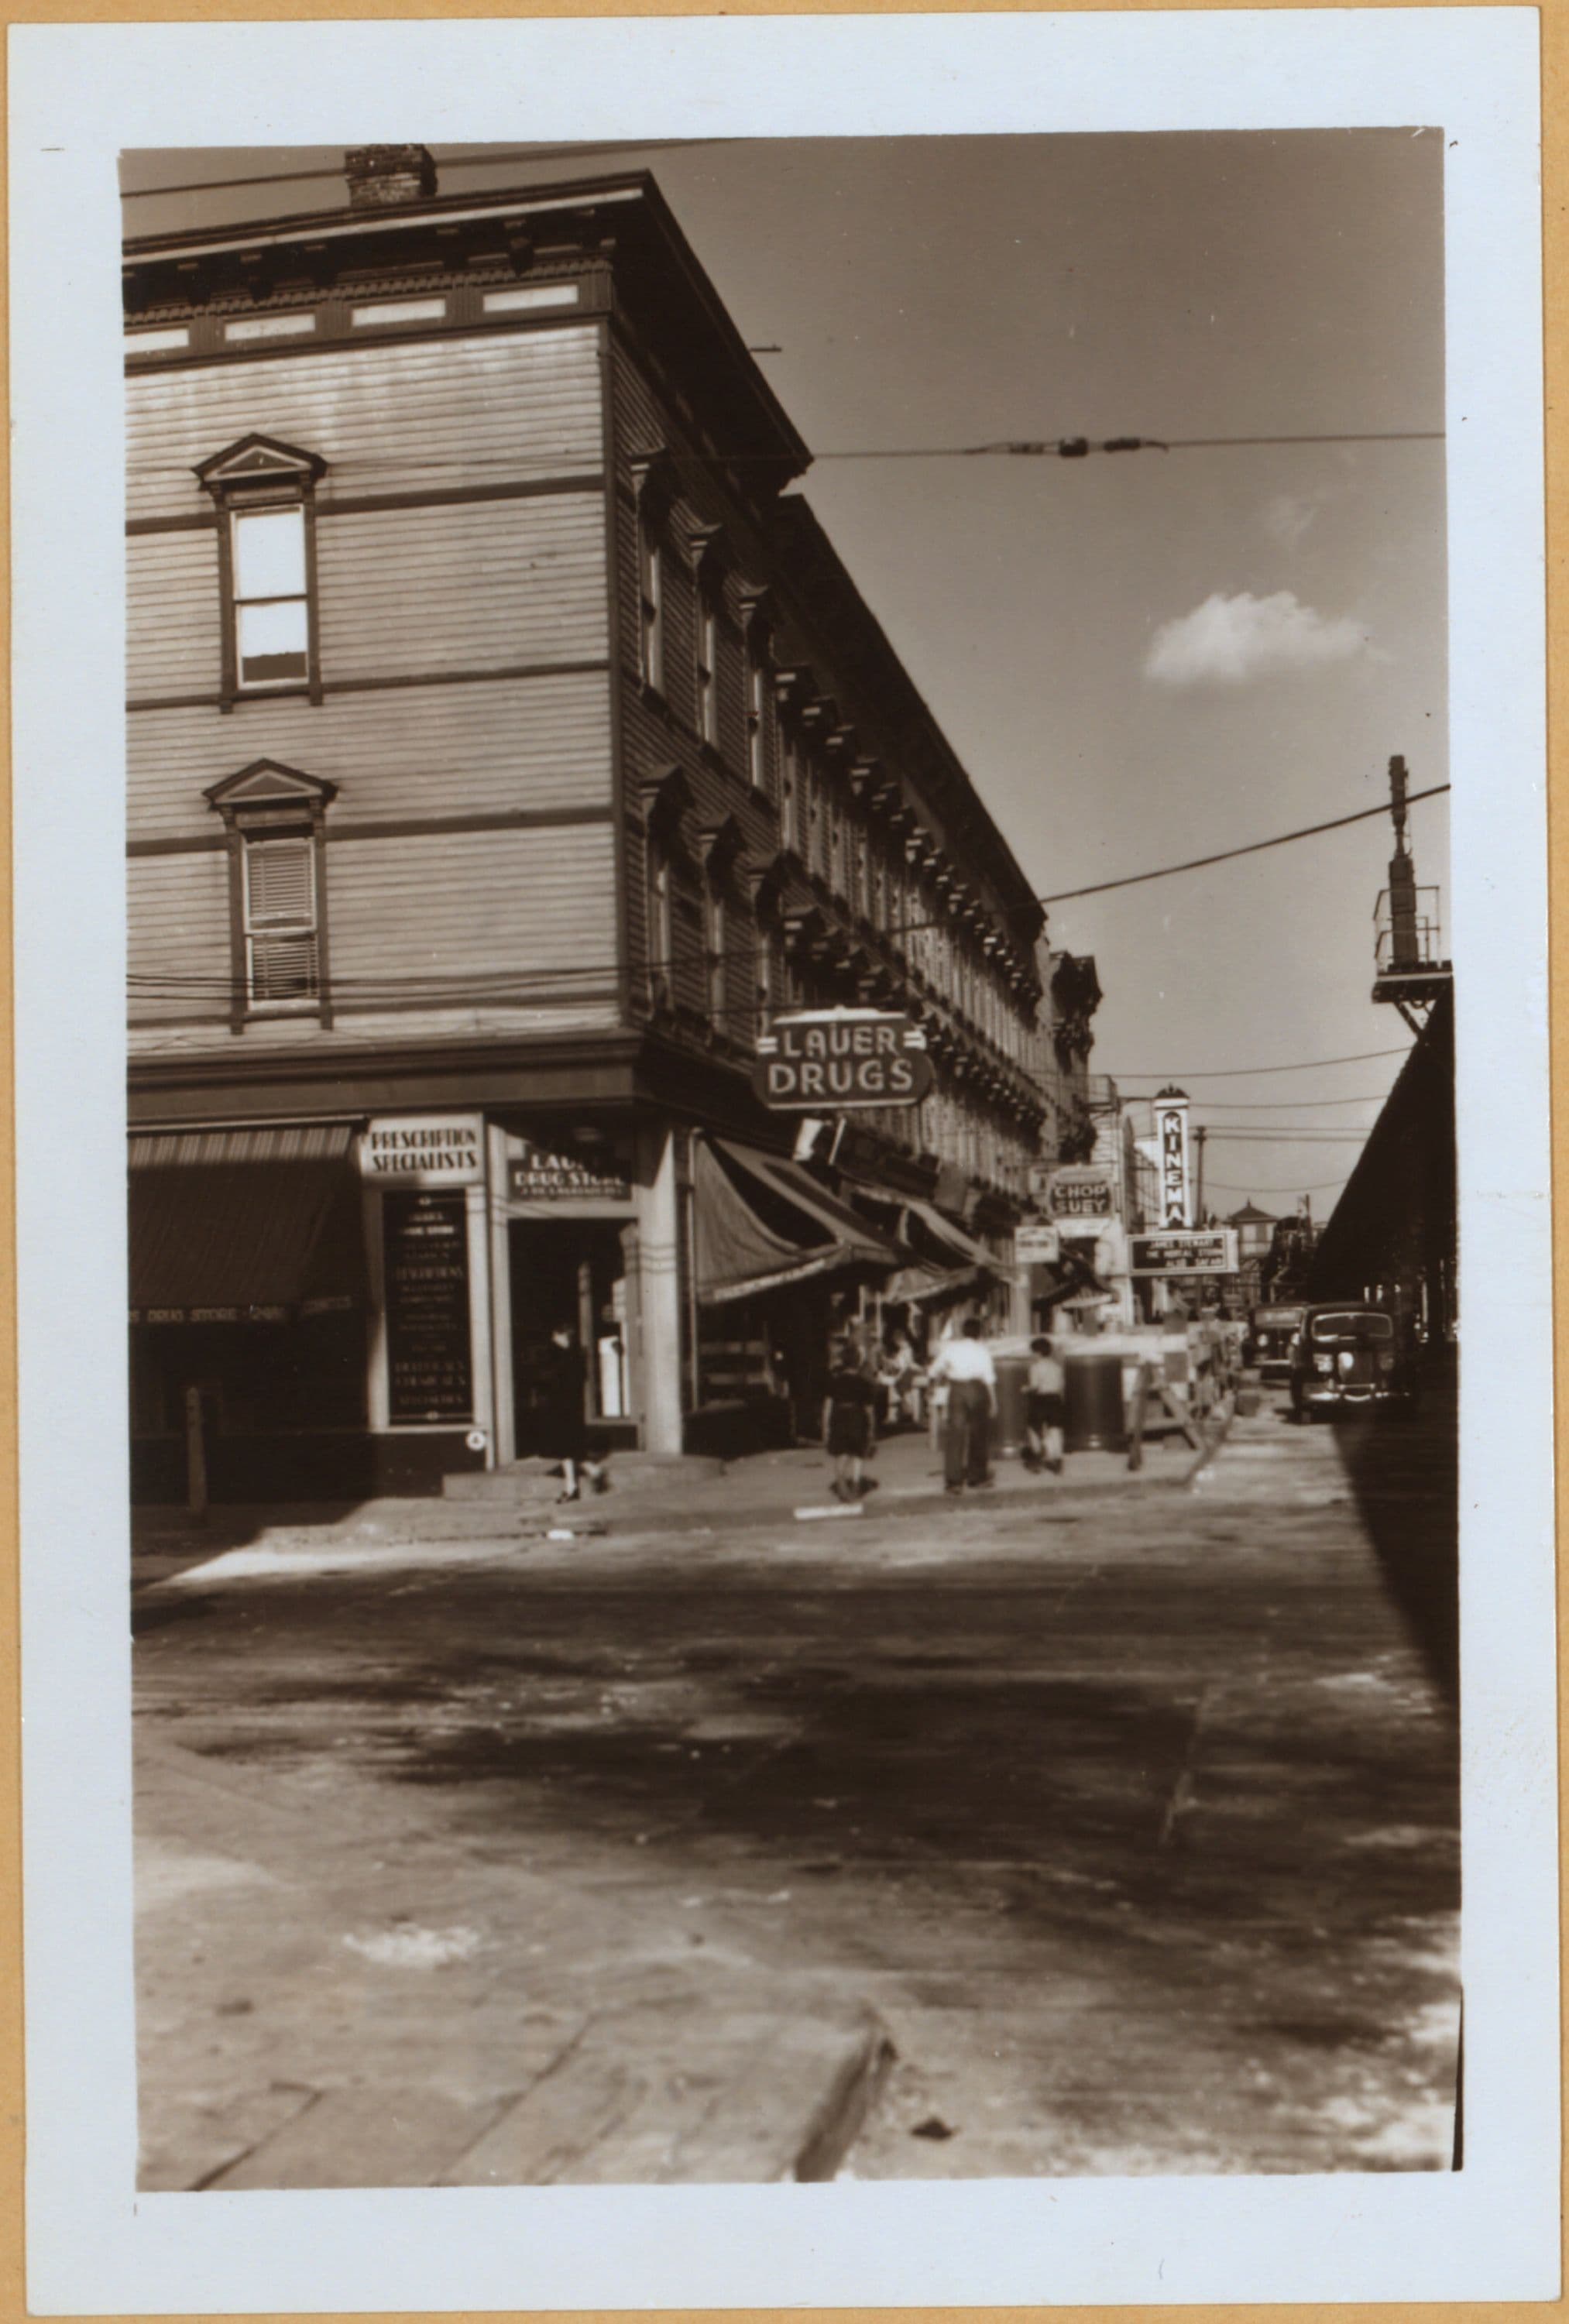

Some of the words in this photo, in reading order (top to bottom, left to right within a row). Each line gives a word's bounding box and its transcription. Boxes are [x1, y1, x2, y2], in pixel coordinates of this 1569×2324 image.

[784, 1024, 898, 1058] LAUER
[769, 1059, 912, 1094] DRUGS
[372, 1128, 476, 1150] PRESCRIPTION
[373, 1151, 477, 1172] SPECIALISTS
[1164, 1117, 1183, 1220] KINEMA
[514, 1172, 565, 1186] DRUG
[1054, 1184, 1106, 1199] CHOP
[1056, 1198, 1106, 1213] SUEY
